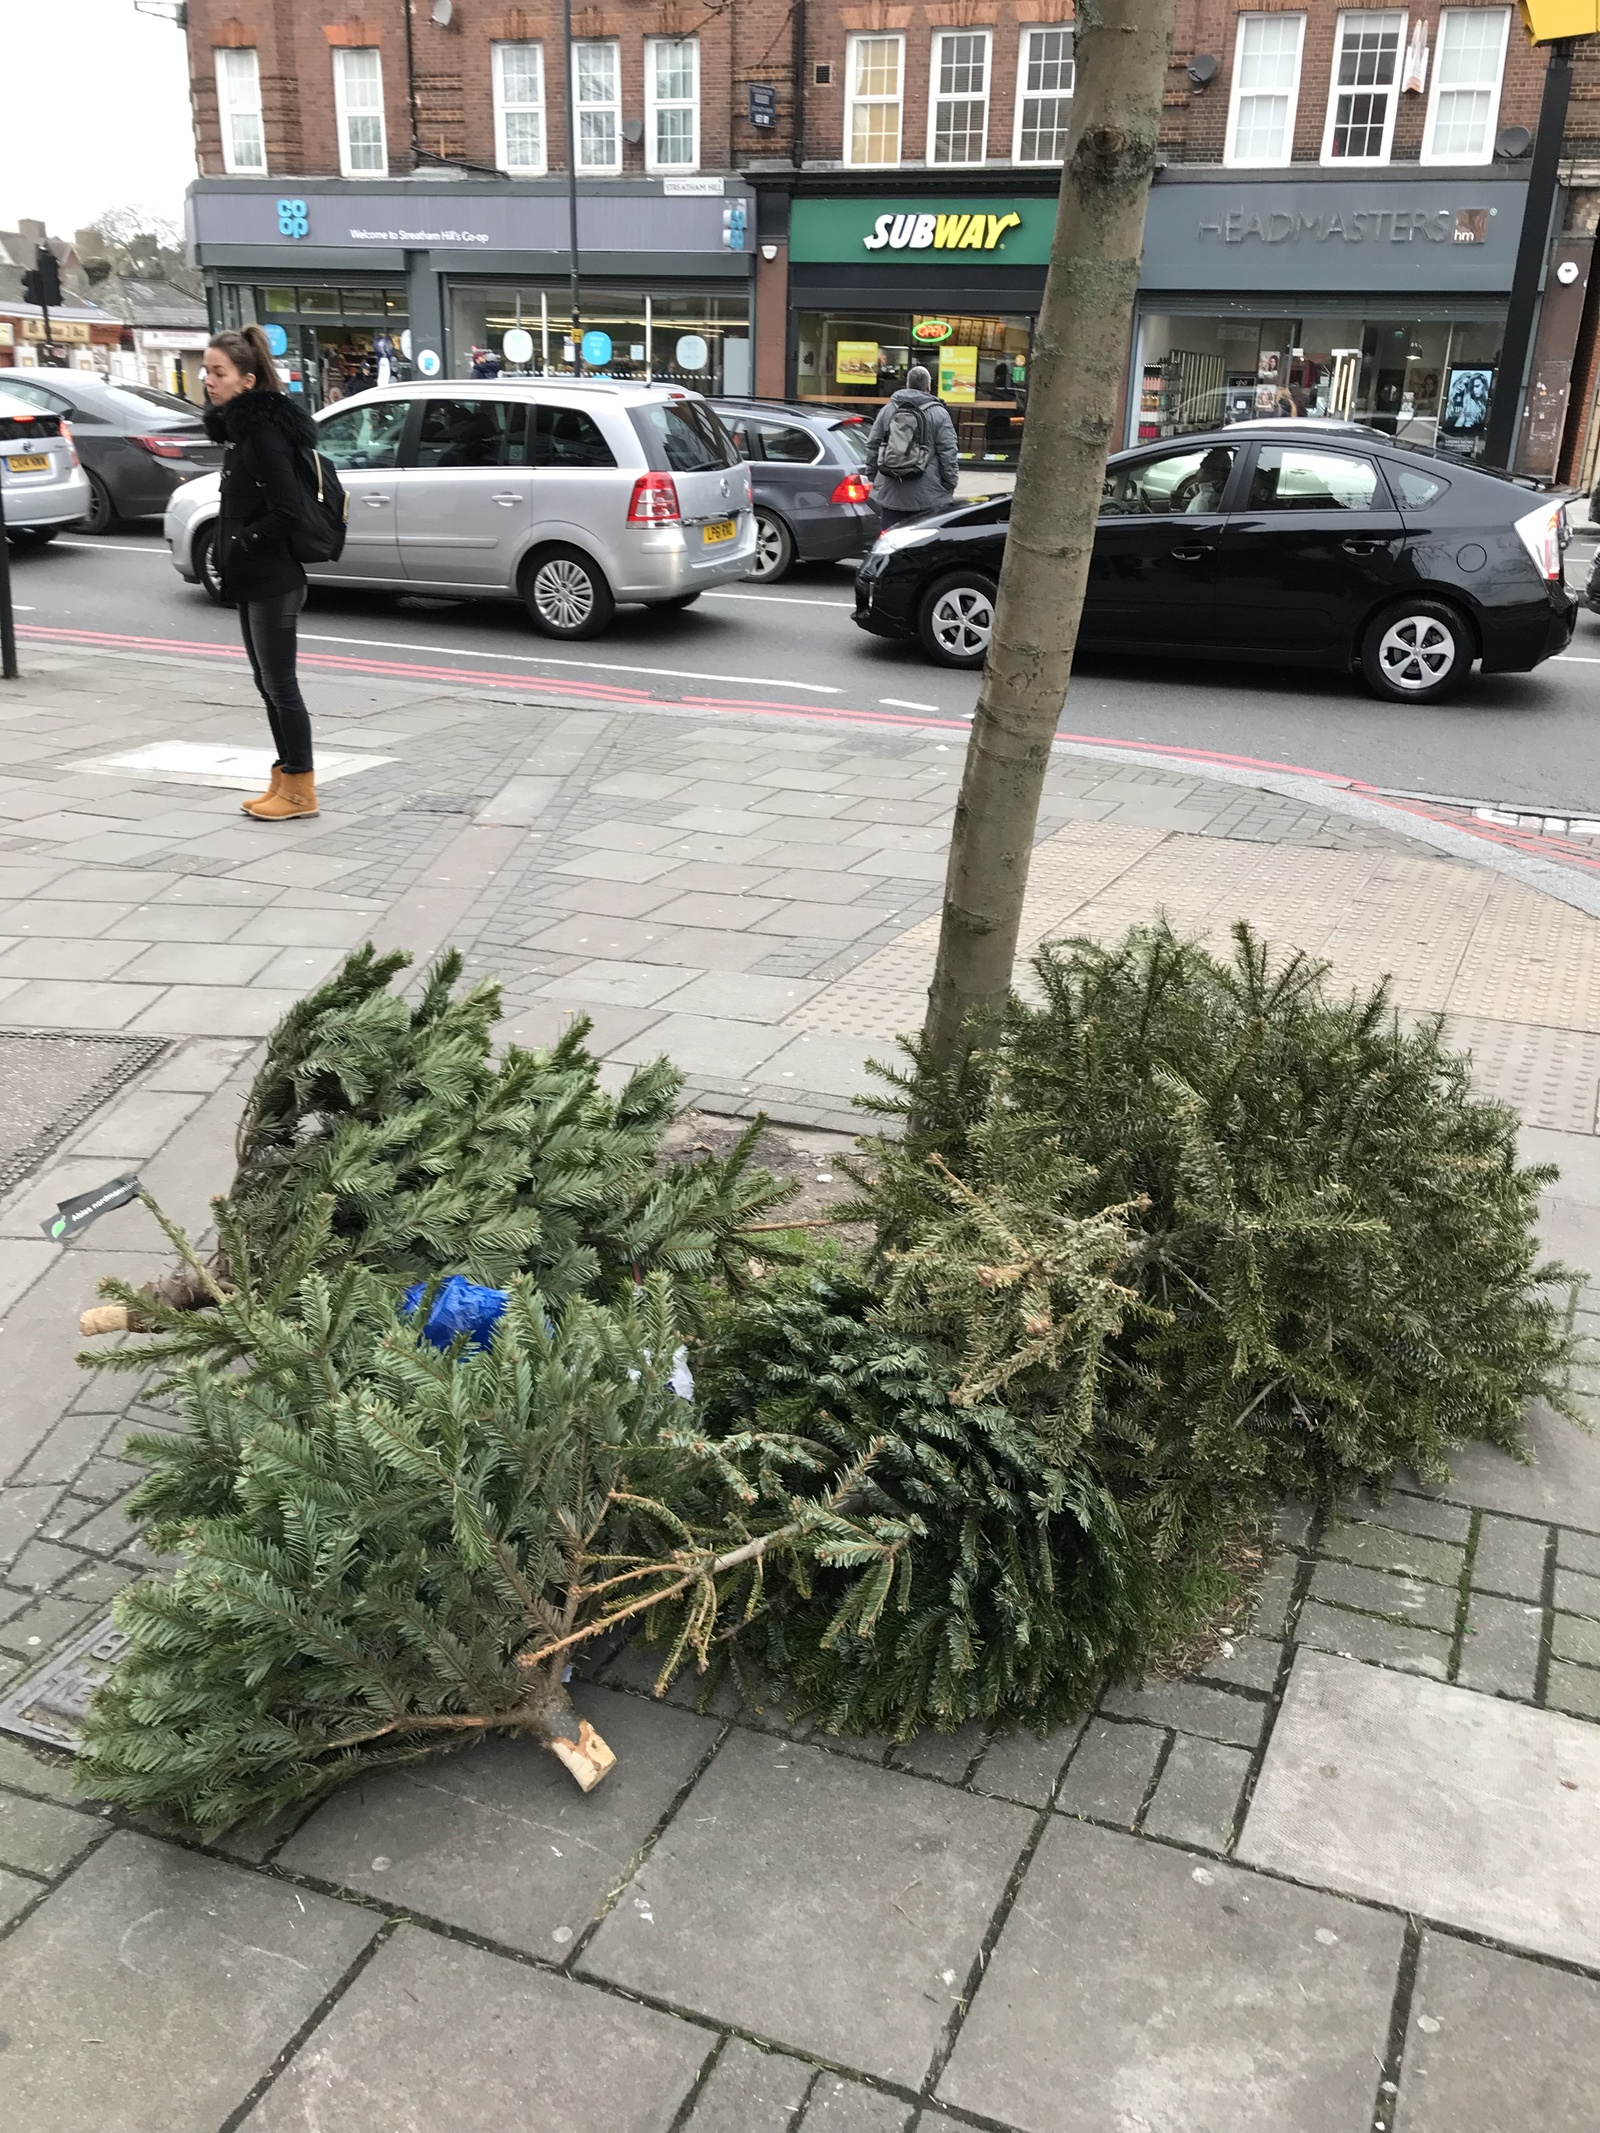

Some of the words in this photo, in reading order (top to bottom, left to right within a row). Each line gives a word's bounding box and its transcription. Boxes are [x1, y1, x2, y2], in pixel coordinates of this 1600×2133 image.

[665, 183, 707, 191] STREATHAM
[708, 183, 722, 191] HILL
[863, 211, 1021, 250] SUBWAY
[1199, 209, 1450, 243] HEADMASTERS
[349, 229, 388, 239] Welcome
[388, 231, 399, 240] to
[398, 230, 441, 240] Streatham
[461, 231, 490, 244] Co-op
[1453, 229, 1475, 242] hm
[917, 325, 948, 338] OPEN
[71, 1206, 94, 1222] Abies
